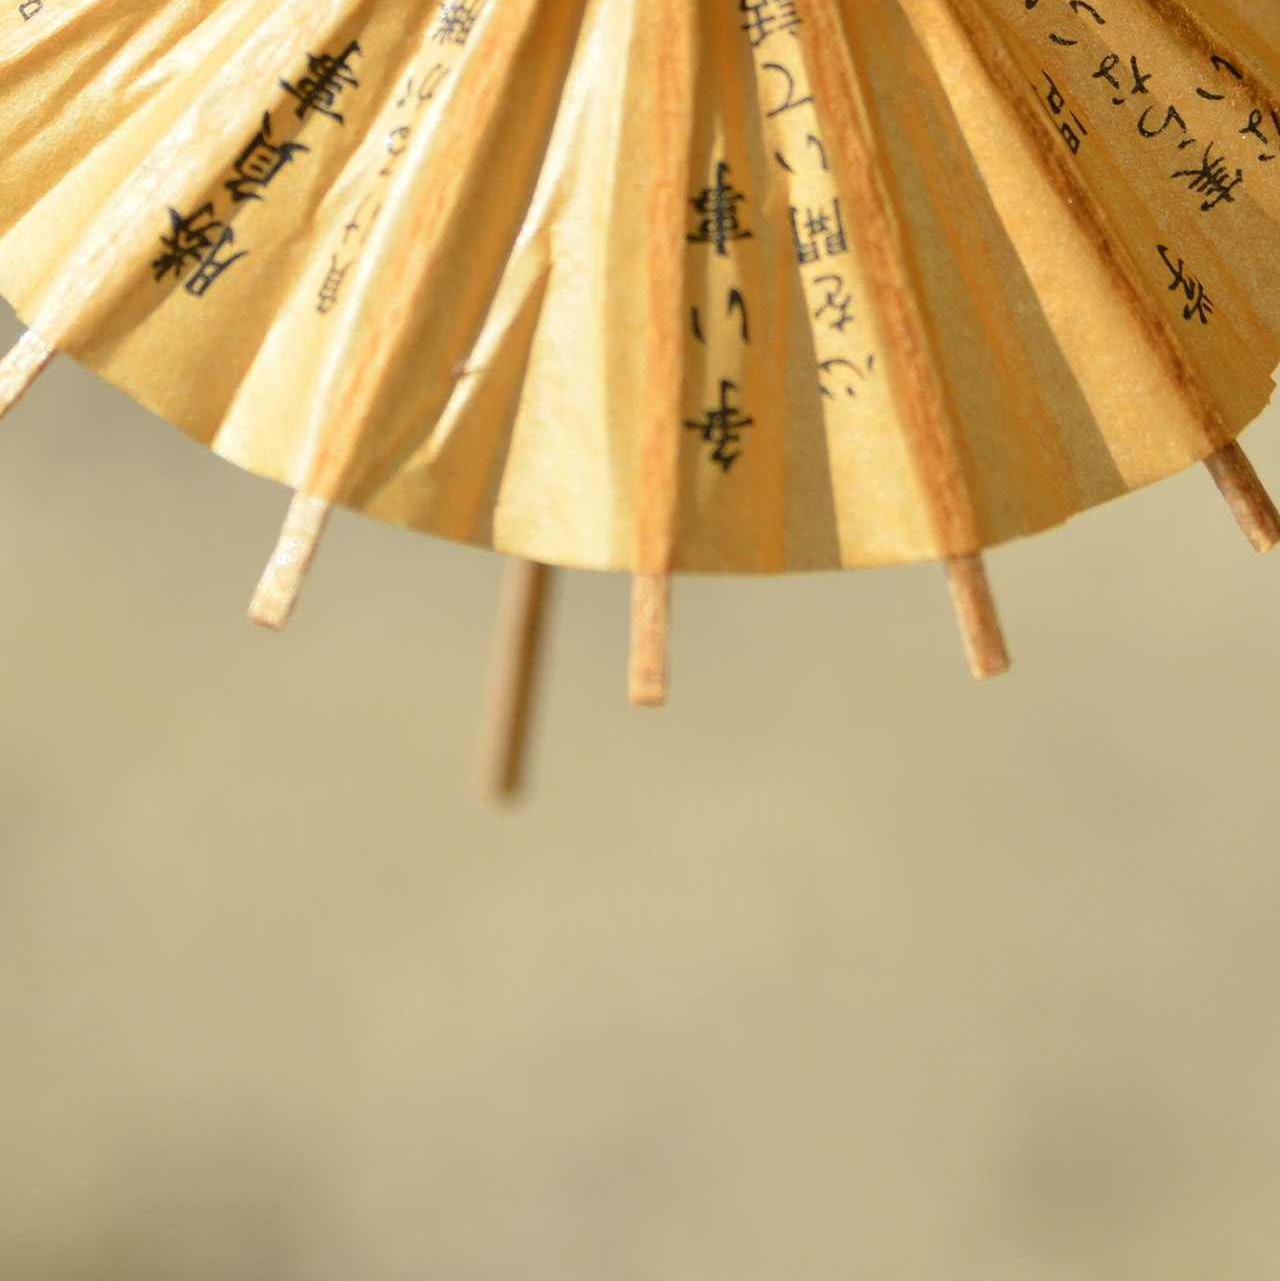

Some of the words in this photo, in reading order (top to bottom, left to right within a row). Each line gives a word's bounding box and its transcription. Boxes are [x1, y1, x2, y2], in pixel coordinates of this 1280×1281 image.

[153, 39, 362, 297] 勝負事
[684, 160, 754, 474] 争い事
